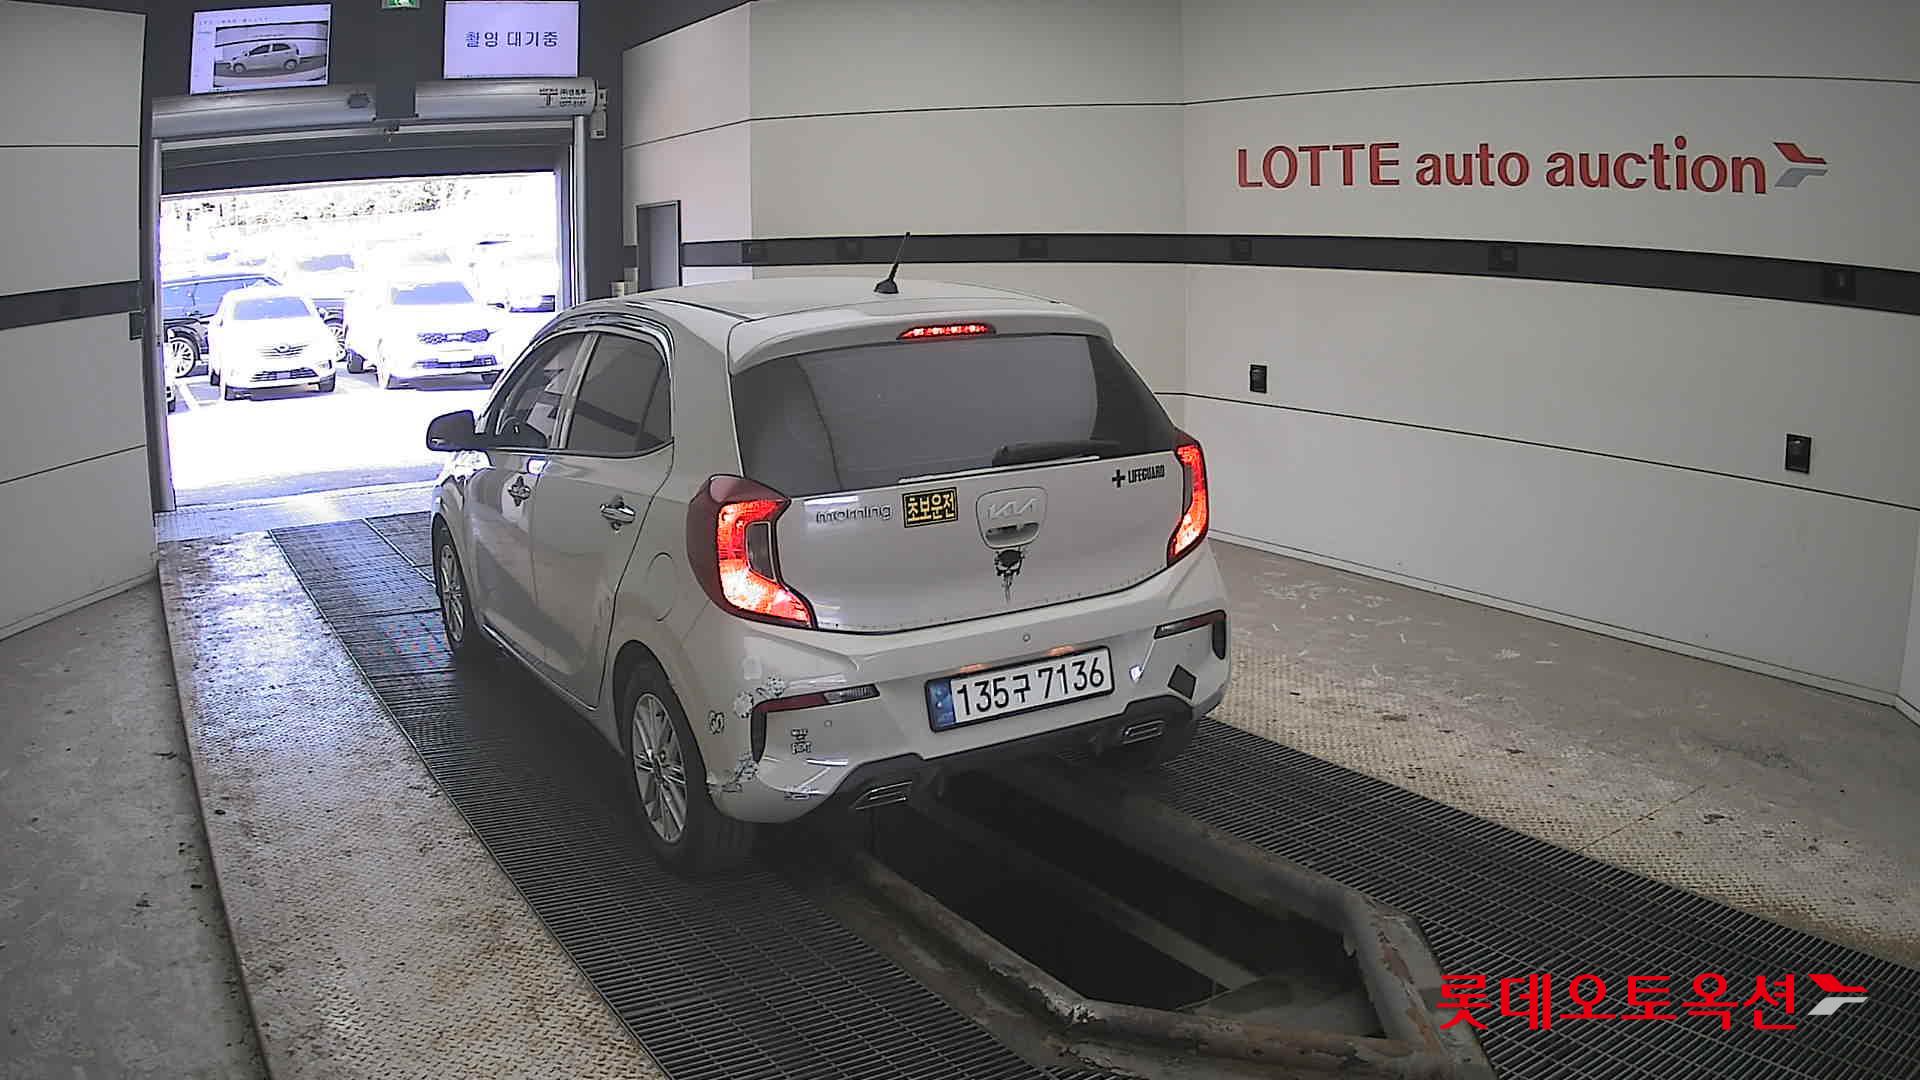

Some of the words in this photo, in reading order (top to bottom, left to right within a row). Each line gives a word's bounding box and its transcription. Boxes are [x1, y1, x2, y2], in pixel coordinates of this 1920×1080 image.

[466, 31, 498, 48] 촬영
[507, 31, 558, 48] 대기중
[1237, 142, 1400, 189] LOTTE
[1415, 143, 1530, 187] auto
[1545, 135, 1766, 194] auction
[1127, 464, 1165, 483] LIFEGUARD
[816, 504, 891, 524] morning
[907, 492, 956, 522] 초보운전
[1037, 656, 1105, 699] 7136
